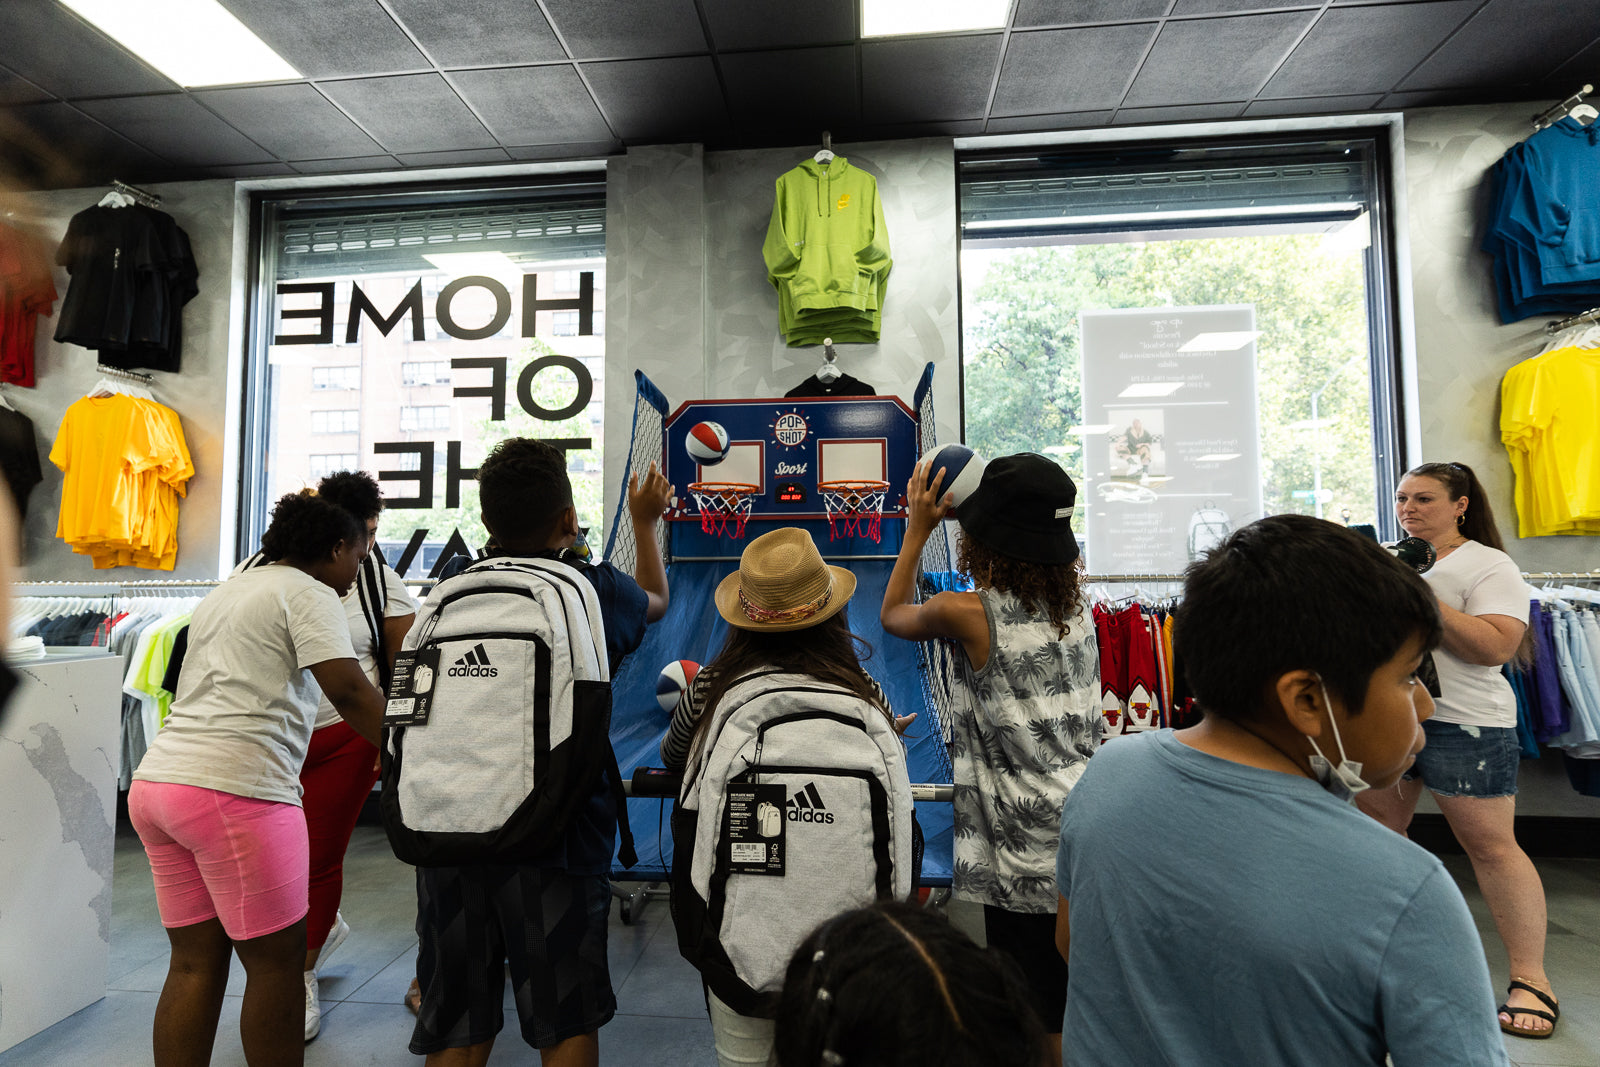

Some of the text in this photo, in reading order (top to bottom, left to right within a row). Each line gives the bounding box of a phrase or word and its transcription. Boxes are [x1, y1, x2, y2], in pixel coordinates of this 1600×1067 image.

[779, 415, 803, 429] POP
[779, 431, 802, 444] SHOT
[775, 461, 808, 476] Sport
[448, 664, 498, 678] adidas
[786, 806, 835, 825] didas
